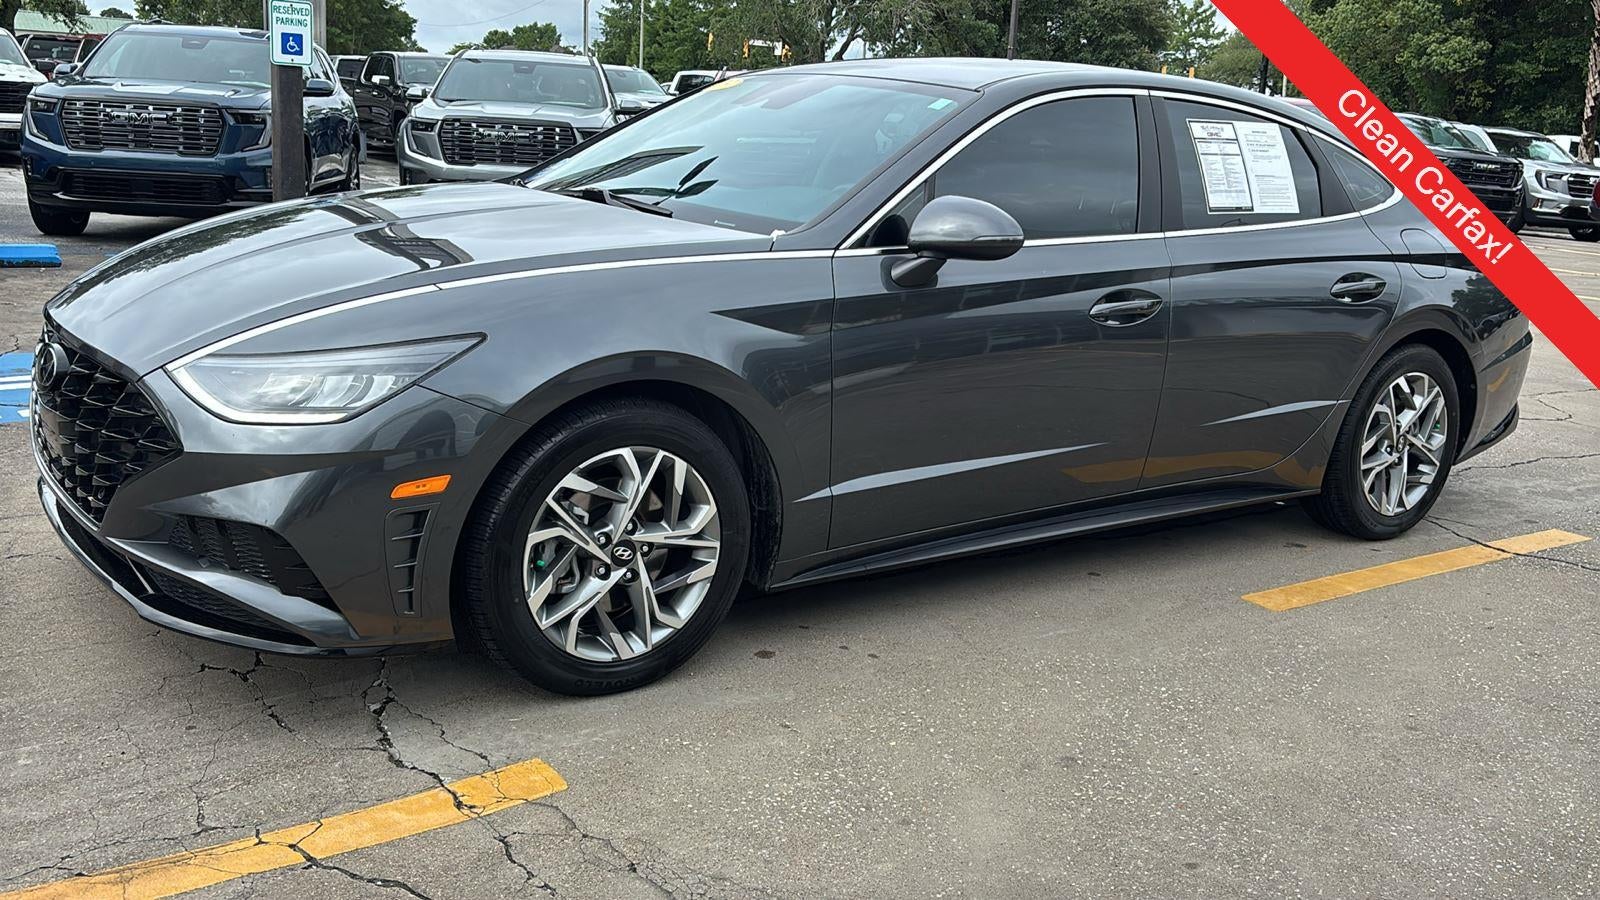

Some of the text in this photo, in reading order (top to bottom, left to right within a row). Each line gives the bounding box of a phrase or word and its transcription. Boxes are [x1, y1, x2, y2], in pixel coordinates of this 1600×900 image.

[272, 5, 310, 16] RESERVED
[275, 16, 308, 28] PARKING
[111, 111, 167, 125] GMC
[483, 131, 530, 142] GMC
